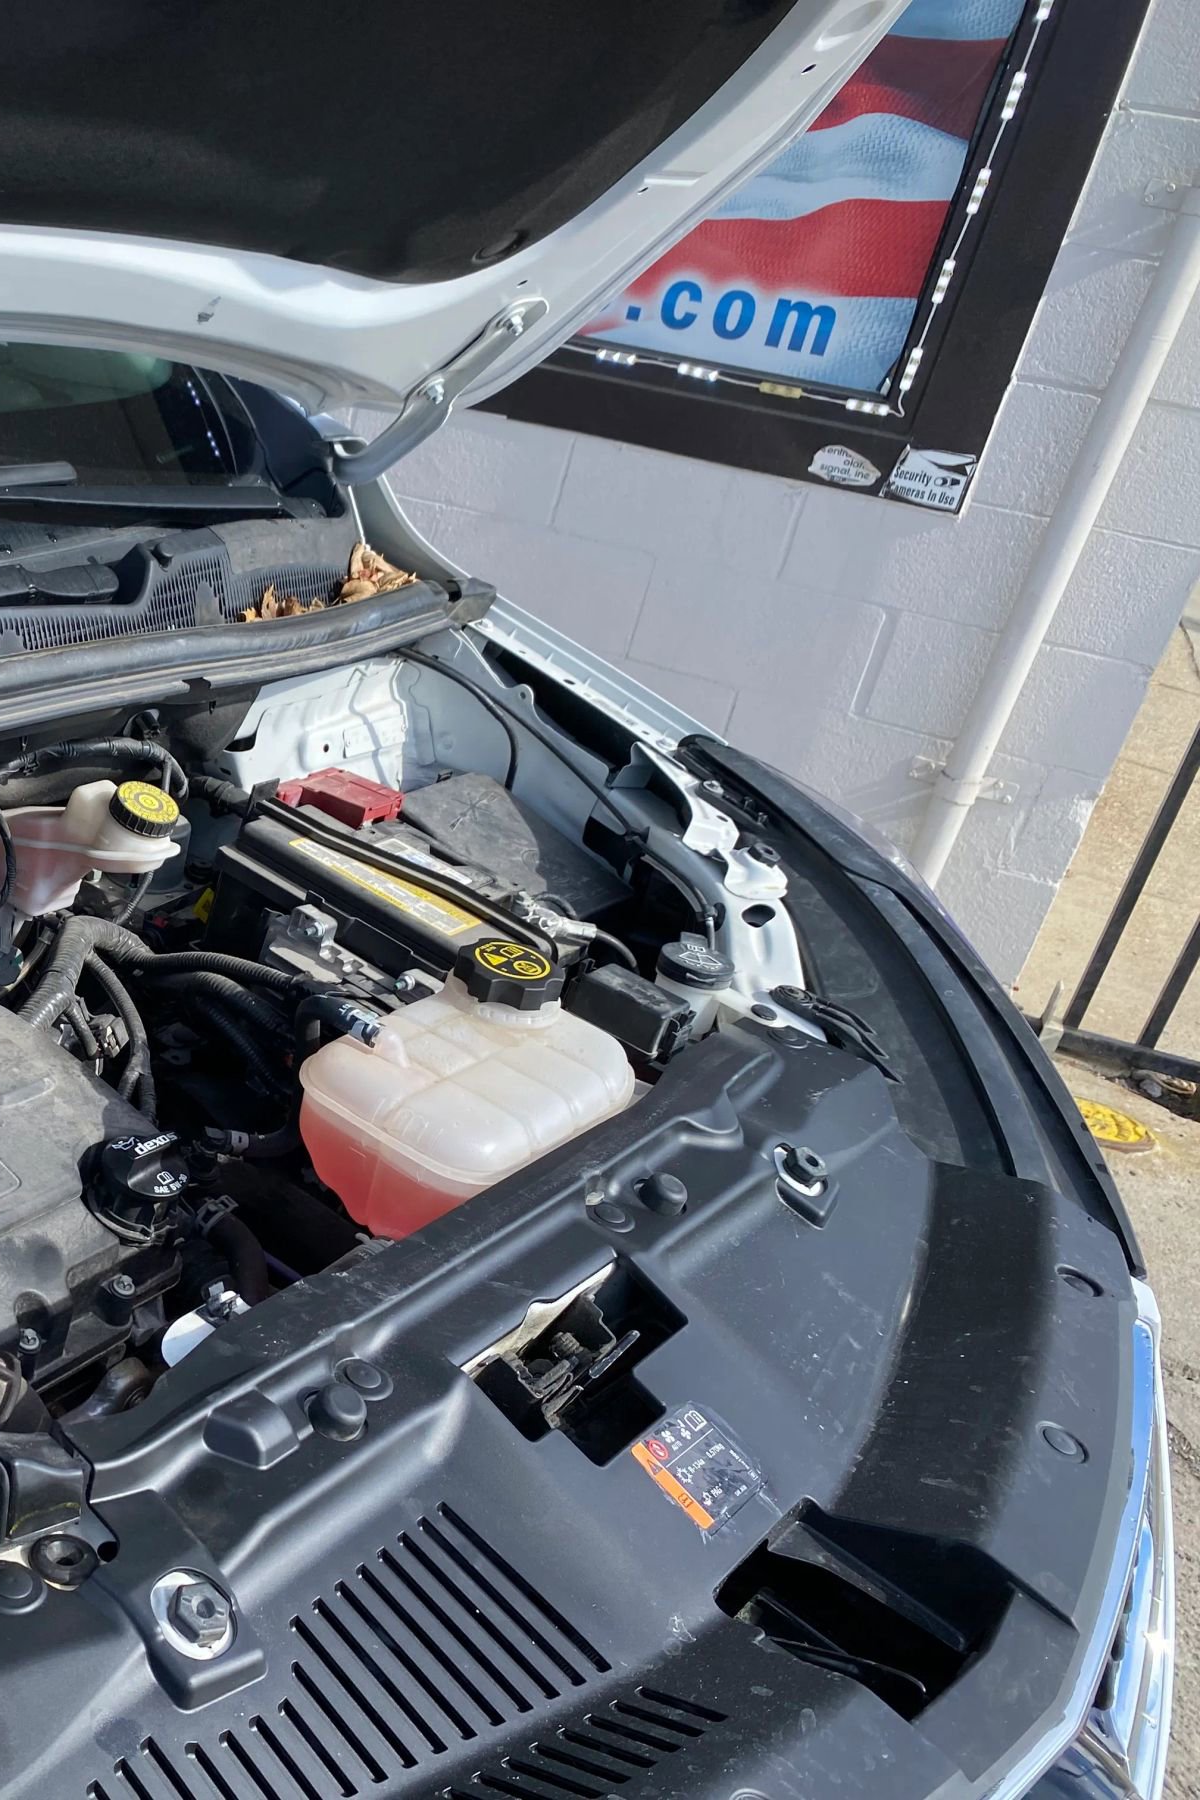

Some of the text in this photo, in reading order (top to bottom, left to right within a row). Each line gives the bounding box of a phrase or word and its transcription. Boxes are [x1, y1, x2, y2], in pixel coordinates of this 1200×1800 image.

[893, 466, 932, 486] Security
[927, 488, 936, 502] In
[938, 491, 955, 505] Use
[134, 1131, 178, 1155] dexos
[153, 1185, 170, 1193] SAE
